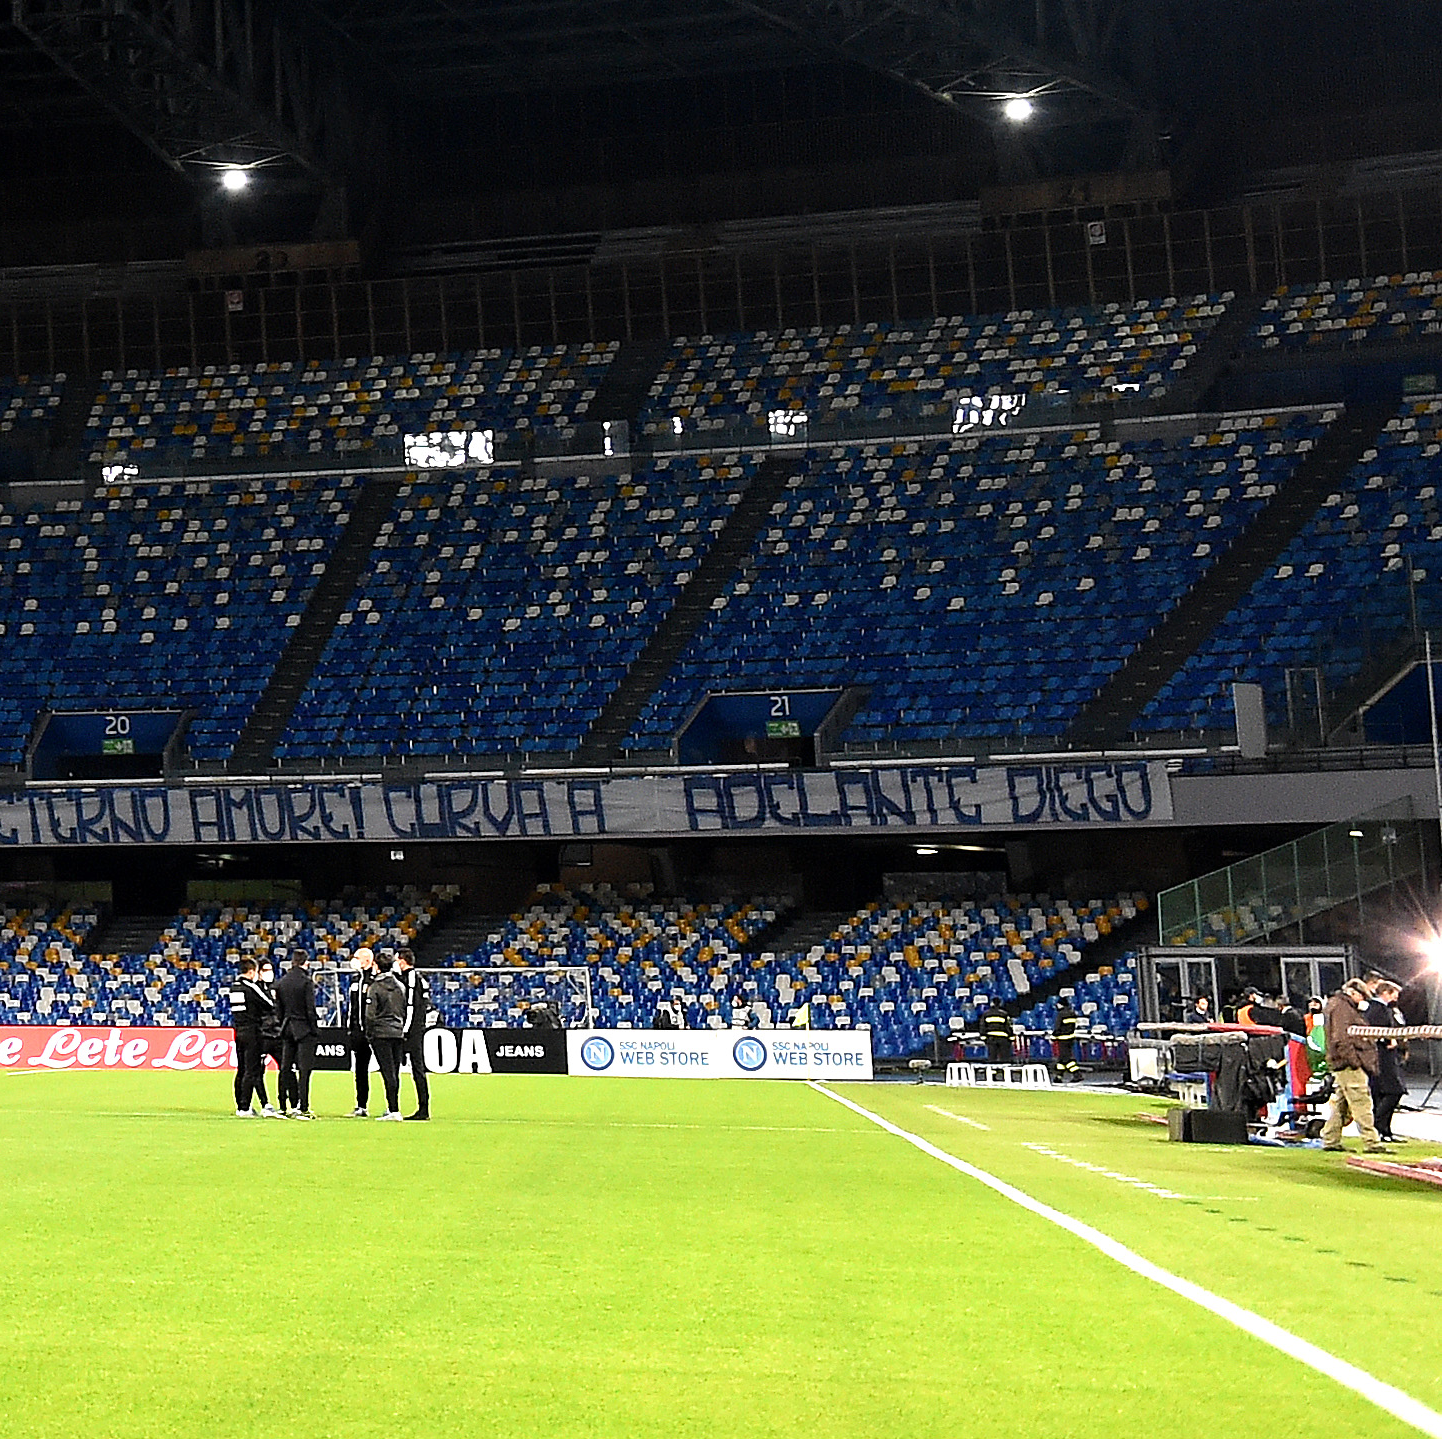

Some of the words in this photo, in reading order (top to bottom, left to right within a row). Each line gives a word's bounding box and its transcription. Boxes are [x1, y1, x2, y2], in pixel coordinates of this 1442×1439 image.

[769, 696, 790, 716] 21
[105, 716, 130, 735] 20
[190, 785, 365, 842] AMORE!
[382, 781, 552, 839] CURVA
[567, 780, 607, 835] A
[684, 767, 981, 831] ADELANTE
[1007, 760, 1153, 823] DIEGO
[28, 1027, 149, 1069] Lete
[495, 1044, 545, 1058] JEANS
[619, 1041, 638, 1050] SSC
[640, 1041, 675, 1050] NAPOLI
[772, 1041, 791, 1051] SSC
[620, 1051, 655, 1065] WEB
[660, 1051, 710, 1066] STORE
[773, 1051, 808, 1065] WEB
[813, 1052, 865, 1067] STORE
